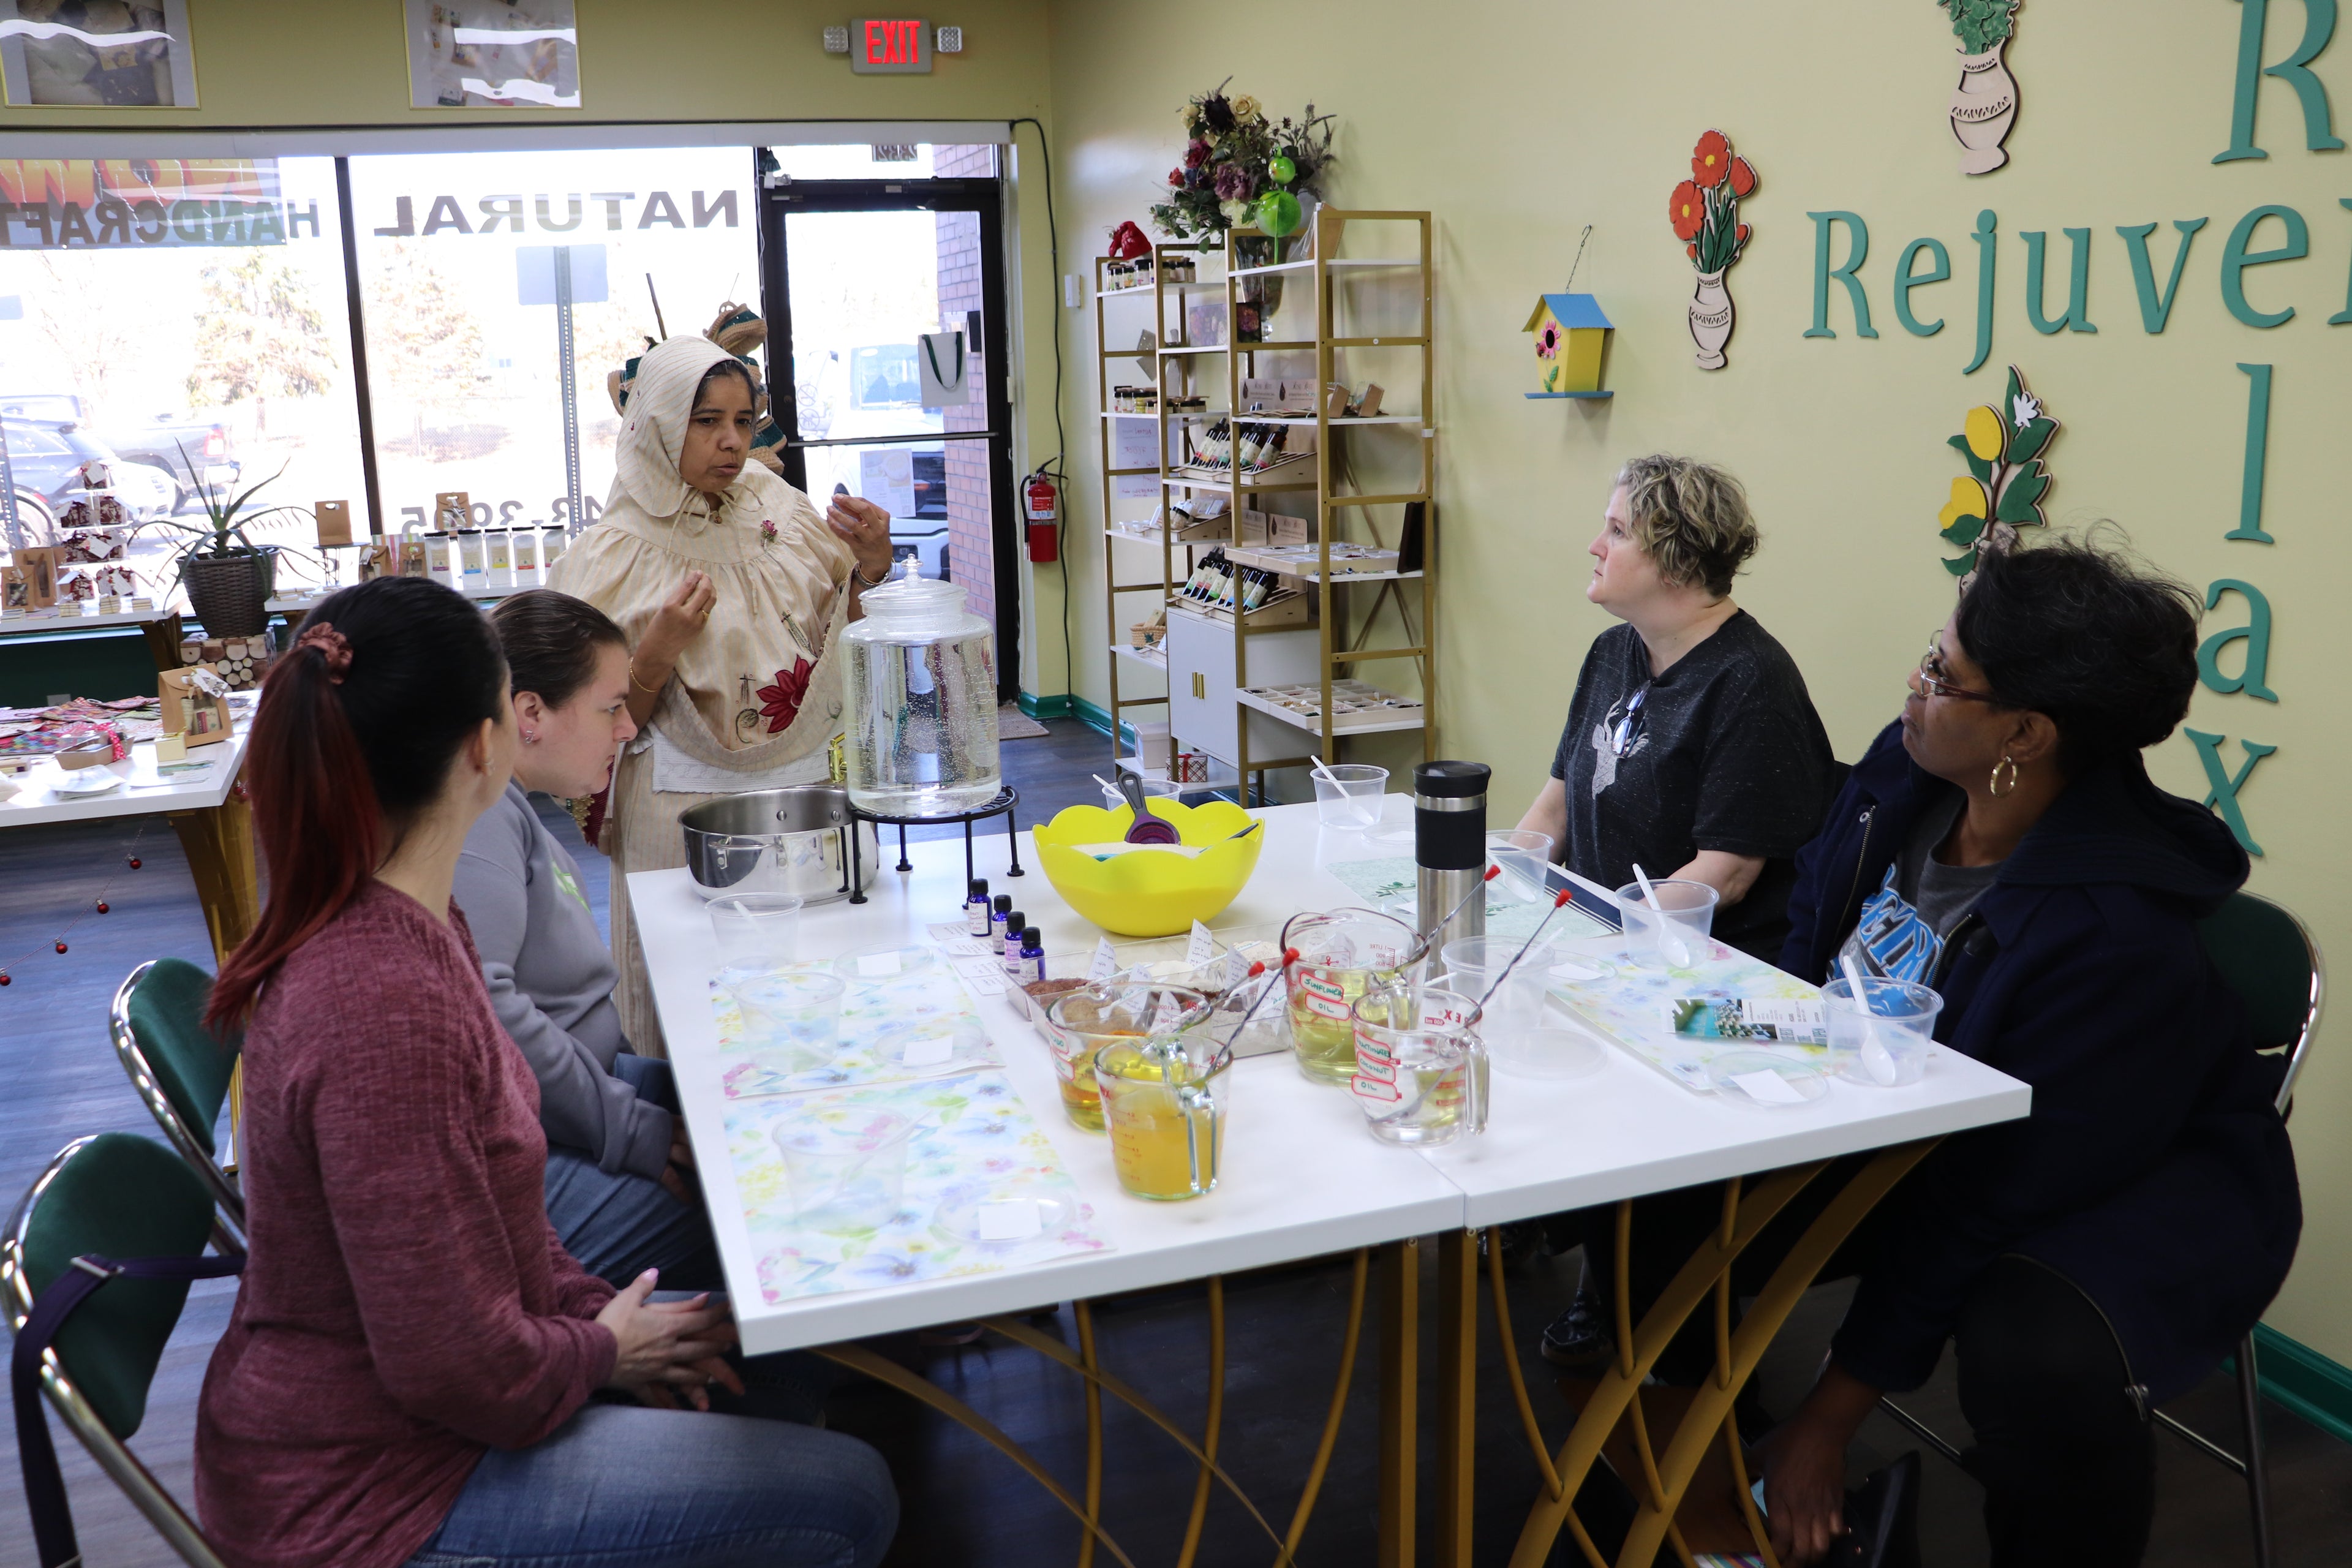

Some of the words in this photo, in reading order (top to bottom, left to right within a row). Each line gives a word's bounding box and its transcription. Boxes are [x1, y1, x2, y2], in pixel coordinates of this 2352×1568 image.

[865, 20, 921, 64] EXIT
[1303, 978, 1344, 998] SUNFLOWER
[1318, 1003, 1335, 1013] OIL
[1359, 1057, 1390, 1076] COCONUT
[1360, 1080, 1378, 1091] OIL
